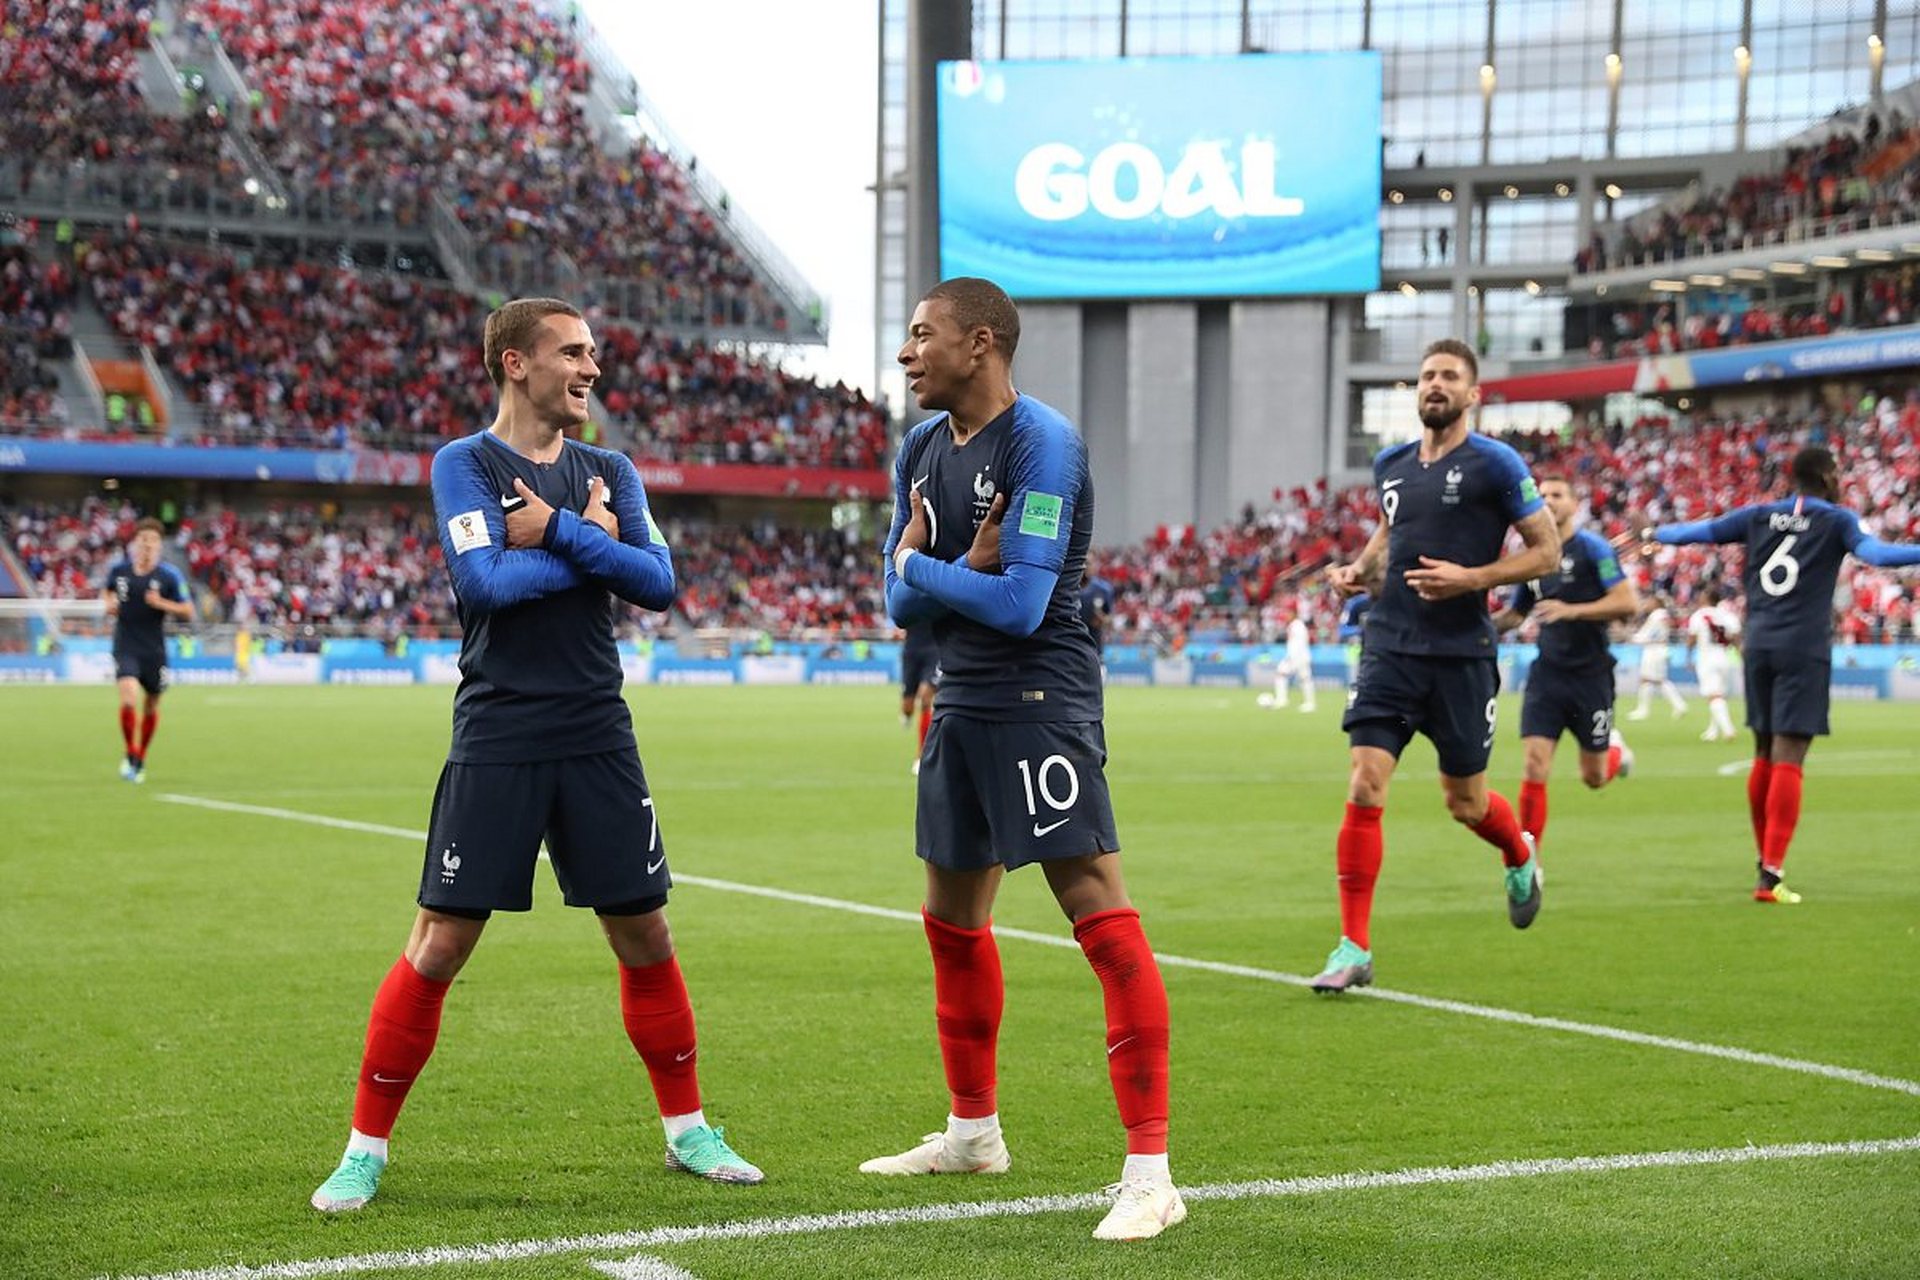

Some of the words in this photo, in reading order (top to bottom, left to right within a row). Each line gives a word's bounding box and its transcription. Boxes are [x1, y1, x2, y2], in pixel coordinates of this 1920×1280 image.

[1015, 141, 1304, 220] GOAL
[1382, 489, 1399, 526] 9
[1760, 534, 1799, 596] 6
[1485, 698, 1497, 734] 9
[1018, 754, 1079, 815] 10
[641, 797, 657, 852] 7
